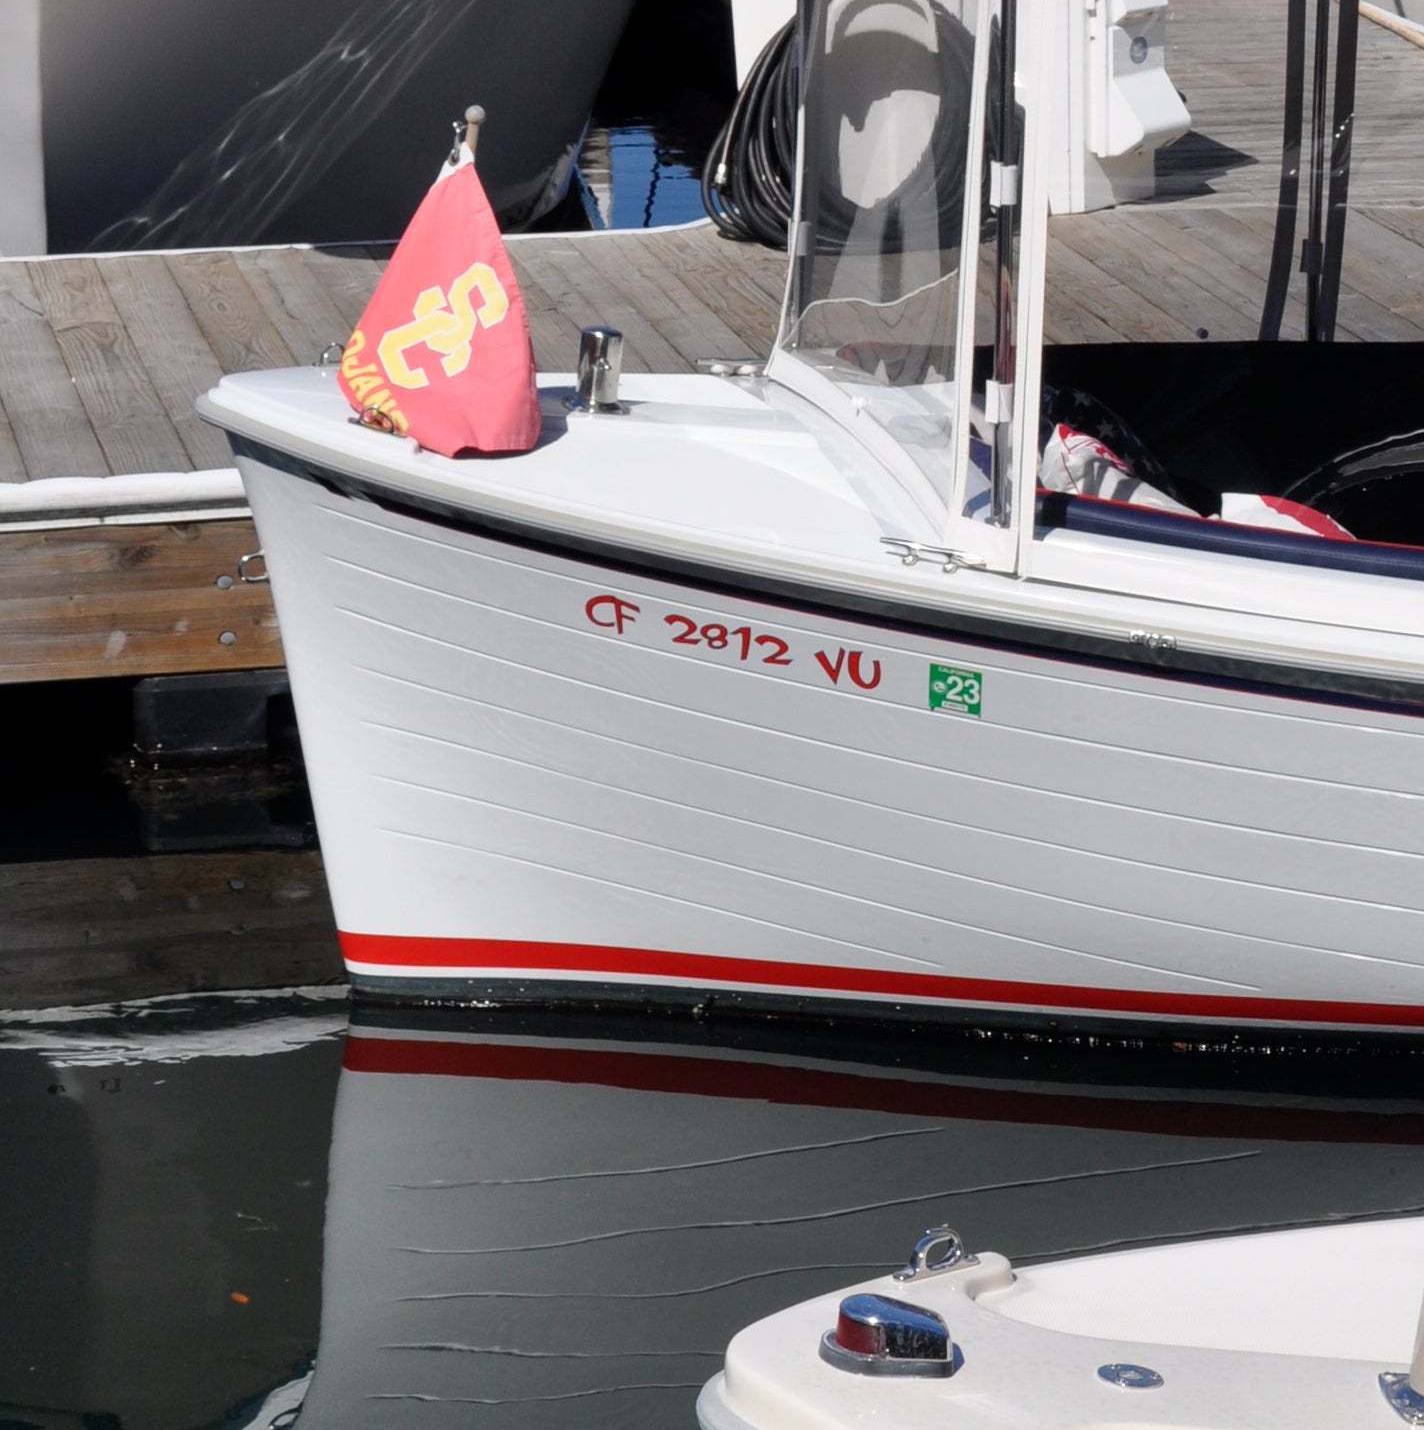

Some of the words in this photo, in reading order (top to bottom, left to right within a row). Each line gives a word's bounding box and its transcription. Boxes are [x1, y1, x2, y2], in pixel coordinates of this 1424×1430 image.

[585, 594, 641, 635] CF
[663, 614, 794, 666] 2812
[814, 646, 882, 690] VU
[945, 675, 981, 705] 23
